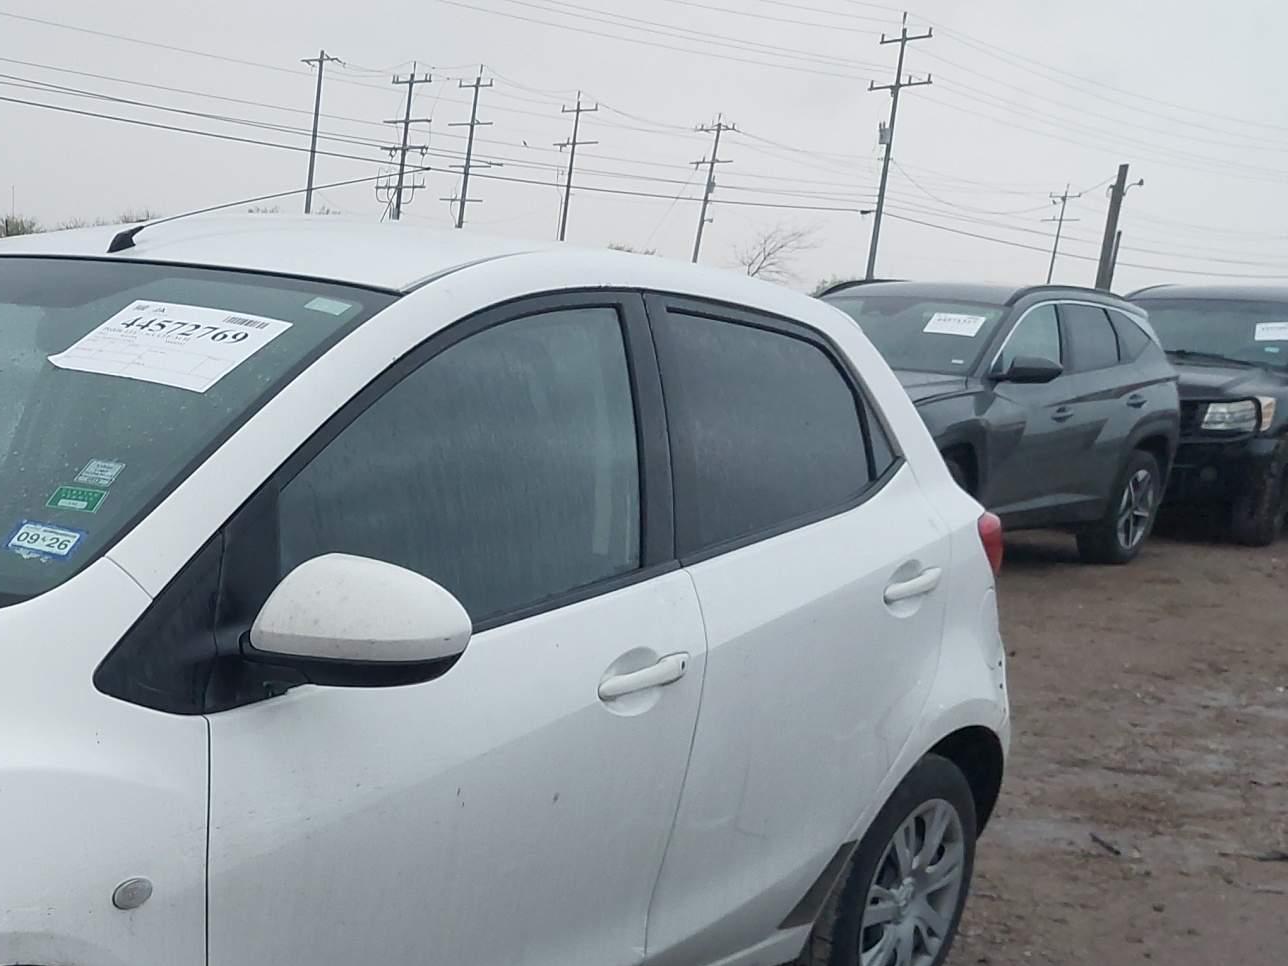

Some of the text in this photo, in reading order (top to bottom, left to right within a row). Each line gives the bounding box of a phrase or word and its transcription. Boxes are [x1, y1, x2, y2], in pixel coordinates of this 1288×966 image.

[120, 316, 249, 344] 44572769
[16, 531, 41, 545] 09
[45, 537, 72, 551] 26
